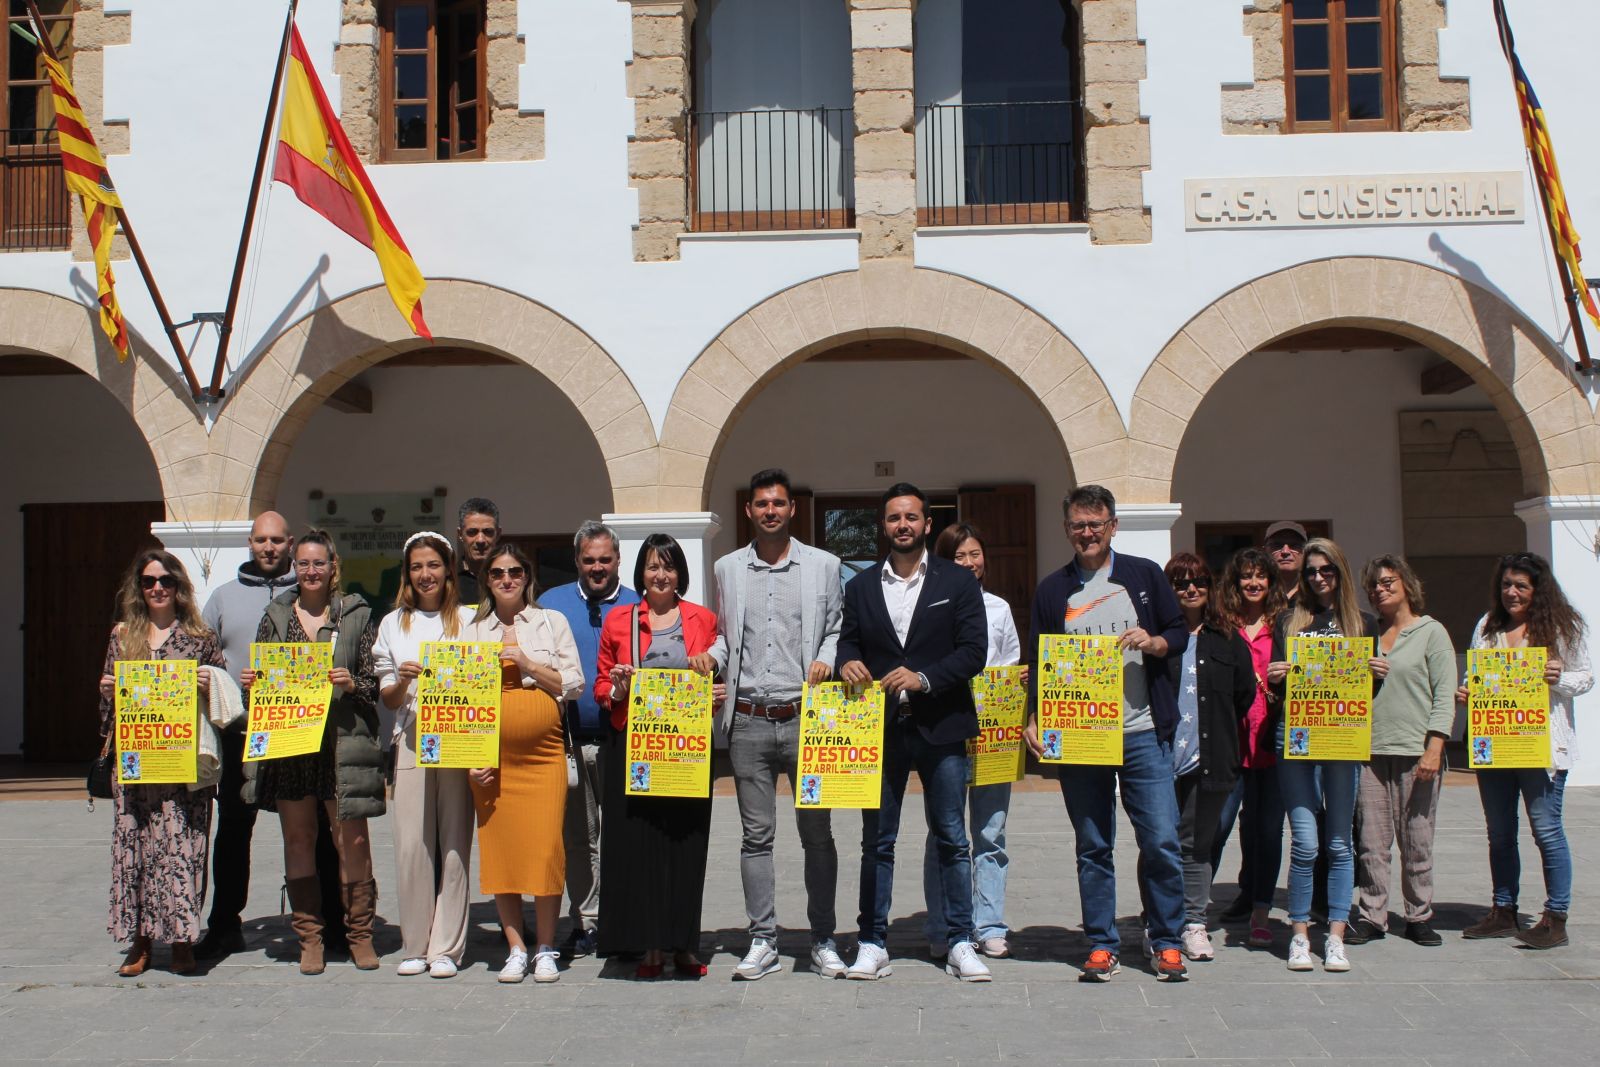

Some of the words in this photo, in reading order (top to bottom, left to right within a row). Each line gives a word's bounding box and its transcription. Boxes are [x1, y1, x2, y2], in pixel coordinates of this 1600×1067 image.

[1194, 184, 1277, 222] CASA
[1297, 181, 1516, 219] CONSISTORIAL
[1042, 690, 1061, 700] XIV
[1064, 690, 1091, 700] FIRA
[1291, 691, 1310, 699] XIV
[1313, 690, 1339, 699] FIRA
[254, 696, 273, 705] XIV
[275, 696, 301, 705] FIRA
[422, 695, 440, 705] XIV
[443, 696, 469, 705] FIRA
[1472, 700, 1489, 709] XIV
[1492, 700, 1518, 709] FIRA
[253, 703, 325, 721] D'ESTOCS
[1042, 700, 1118, 719] D'ESTOCS
[1290, 700, 1367, 716] D'ESTOCS
[120, 713, 137, 723] XIV
[140, 713, 165, 722] FIRA
[421, 705, 496, 722] D'ESTOCS
[1472, 709, 1546, 725] D'ESTOCS
[252, 722, 262, 731] 22
[263, 721, 287, 731] ABRIL
[1042, 718, 1051, 728] 22
[1054, 718, 1079, 729] ABRIL
[1290, 717, 1300, 726] 22
[1302, 717, 1327, 726] ABRIL
[119, 723, 192, 739] D'ESTOCS
[421, 723, 431, 733] 22
[433, 723, 457, 733] ABRIL
[632, 723, 650, 733] XIV
[653, 723, 679, 733] FIRA
[1472, 726, 1481, 736] 22
[1484, 726, 1508, 736] ABRIL
[631, 733, 707, 751] D'ESTOCS
[804, 736, 823, 745] XIV
[825, 736, 852, 745] FIRA
[120, 741, 129, 751] 22
[132, 741, 155, 750] ABRIL
[631, 750, 640, 760] 22
[643, 751, 667, 762] ABRIL
[802, 746, 879, 763] D'ESTOCS
[802, 763, 811, 774] 22
[814, 763, 839, 774] ABRIL
